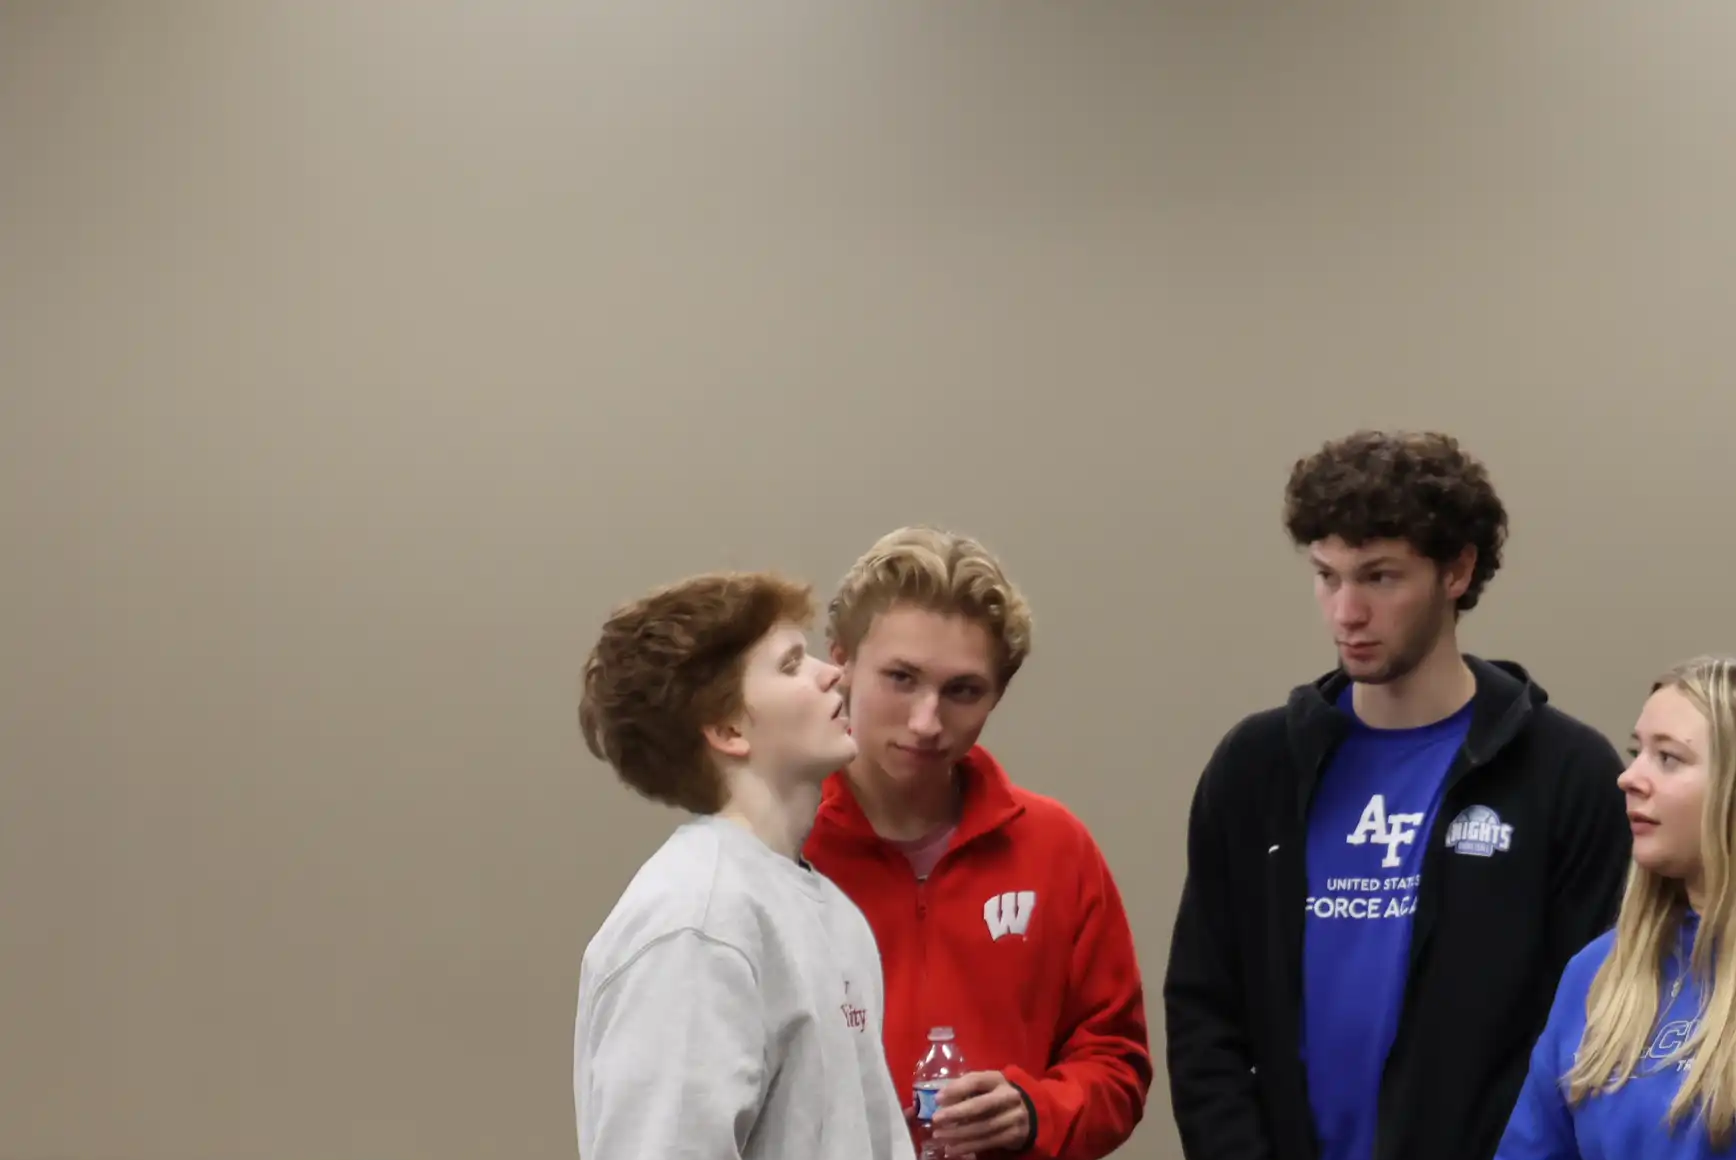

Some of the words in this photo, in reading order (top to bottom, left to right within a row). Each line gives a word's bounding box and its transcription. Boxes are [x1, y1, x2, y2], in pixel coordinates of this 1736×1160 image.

[1326, 878, 1381, 891] UNITED
[983, 890, 1036, 942] W
[1304, 897, 1382, 919] FORCE
